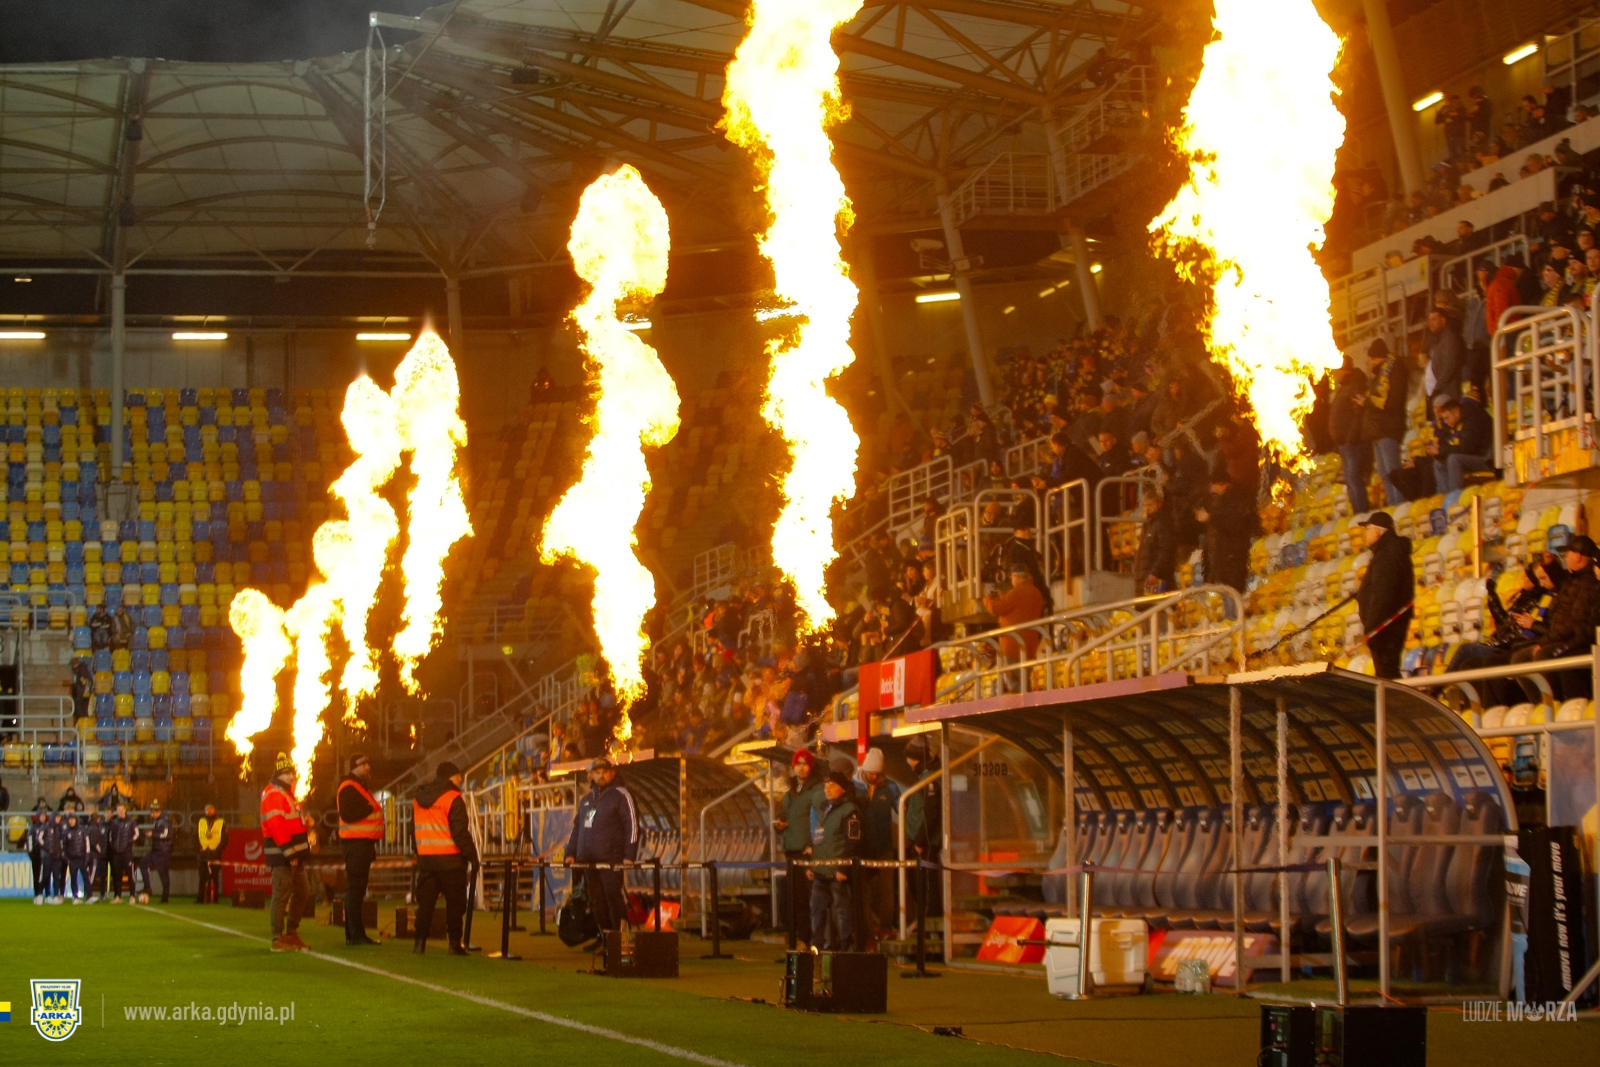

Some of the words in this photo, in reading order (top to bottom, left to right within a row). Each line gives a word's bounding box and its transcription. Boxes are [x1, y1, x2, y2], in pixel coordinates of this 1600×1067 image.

[1550, 841, 1562, 873] move
[0, 861, 30, 890] OW
[1553, 874, 1567, 902] your
[1554, 902, 1567, 922] it's
[1557, 922, 1570, 948] now
